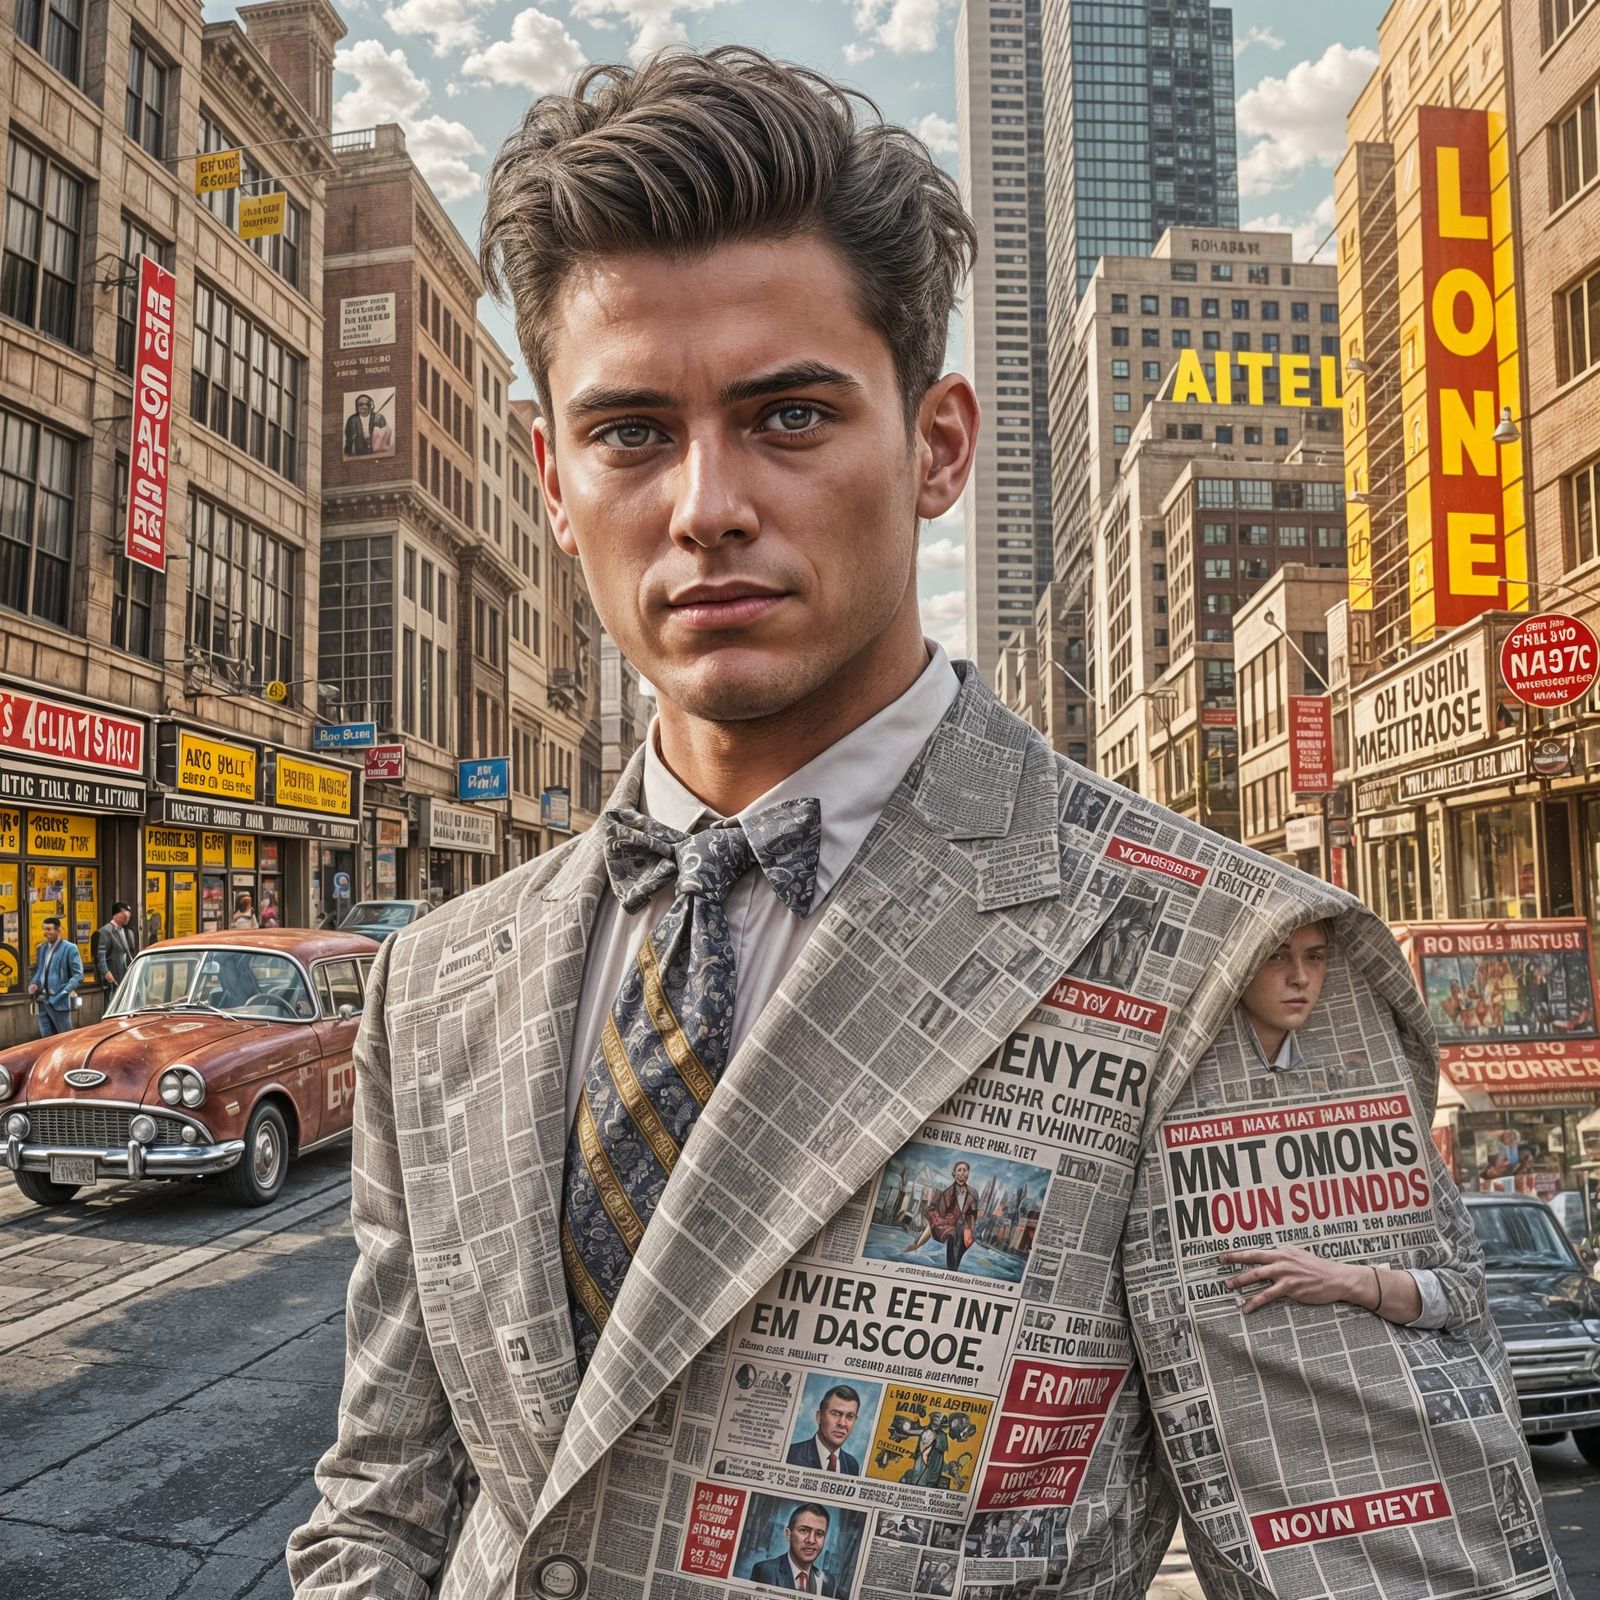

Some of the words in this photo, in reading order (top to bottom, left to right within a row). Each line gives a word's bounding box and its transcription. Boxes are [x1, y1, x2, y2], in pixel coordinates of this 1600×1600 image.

[1172, 349, 1343, 408] AITEL
[1432, 146, 1501, 597] LONE
[1374, 684, 1397, 724] OH
[1169, 1140, 1266, 1197] MNT
[1275, 1122, 1418, 1181] OMONS
[1175, 1186, 1285, 1241] MOUN
[1289, 1167, 1430, 1224] SUINDDS
[751, 1302, 800, 1341] EM
[886, 1286, 952, 1324] EET
[952, 1297, 1013, 1336] INT
[1269, 1504, 1355, 1543] NOVN
[1365, 1489, 1435, 1526] HEYT
